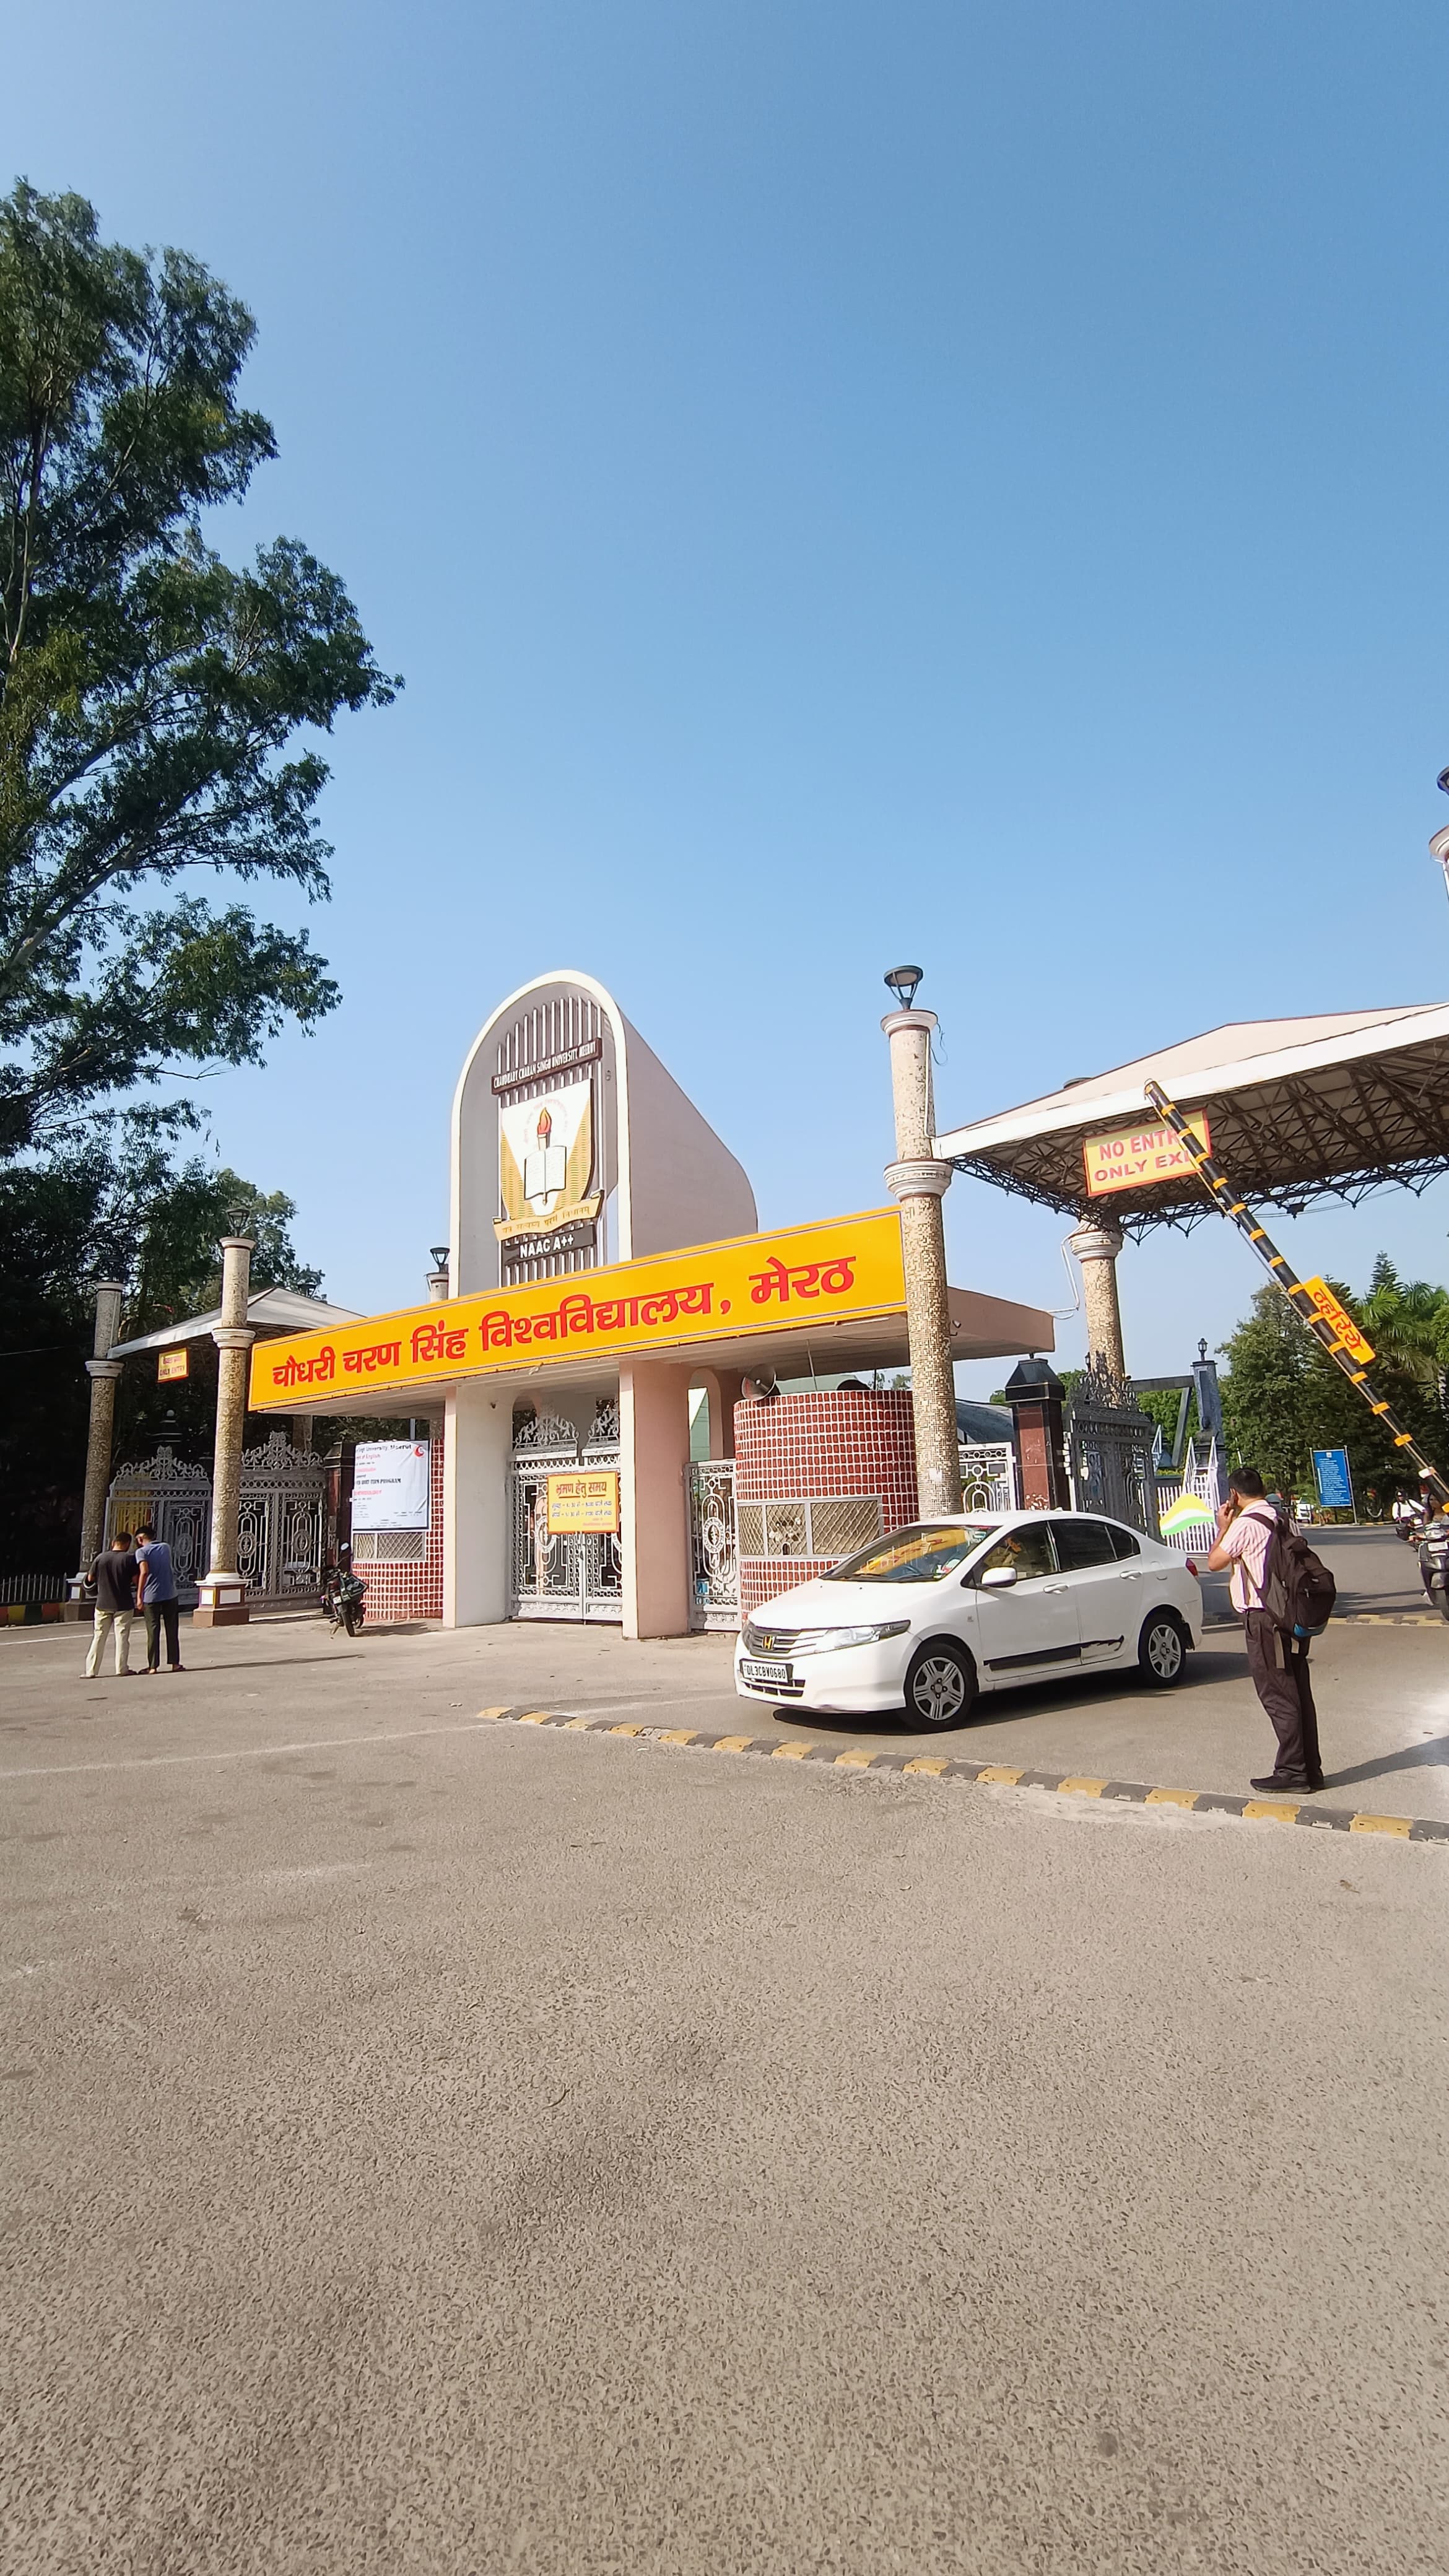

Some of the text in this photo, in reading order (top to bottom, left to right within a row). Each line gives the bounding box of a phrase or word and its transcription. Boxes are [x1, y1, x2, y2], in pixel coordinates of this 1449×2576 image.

[519, 1064, 536, 1080] CHARAN
[537, 1058, 551, 1073] SINGH
[1100, 1128, 1180, 1161] NO ENTR
[1094, 1150, 1190, 1181] ONLY EXI
[520, 1234, 574, 1258] NAAC A++
[272, 1346, 336, 1386] चौधरी
[343, 1341, 401, 1373] चरण
[411, 1320, 469, 1363] सिंह
[749, 1256, 856, 1304] मेरठ
[575, 1479, 587, 1498] हेतु
[588, 1481, 607, 1493] समय
